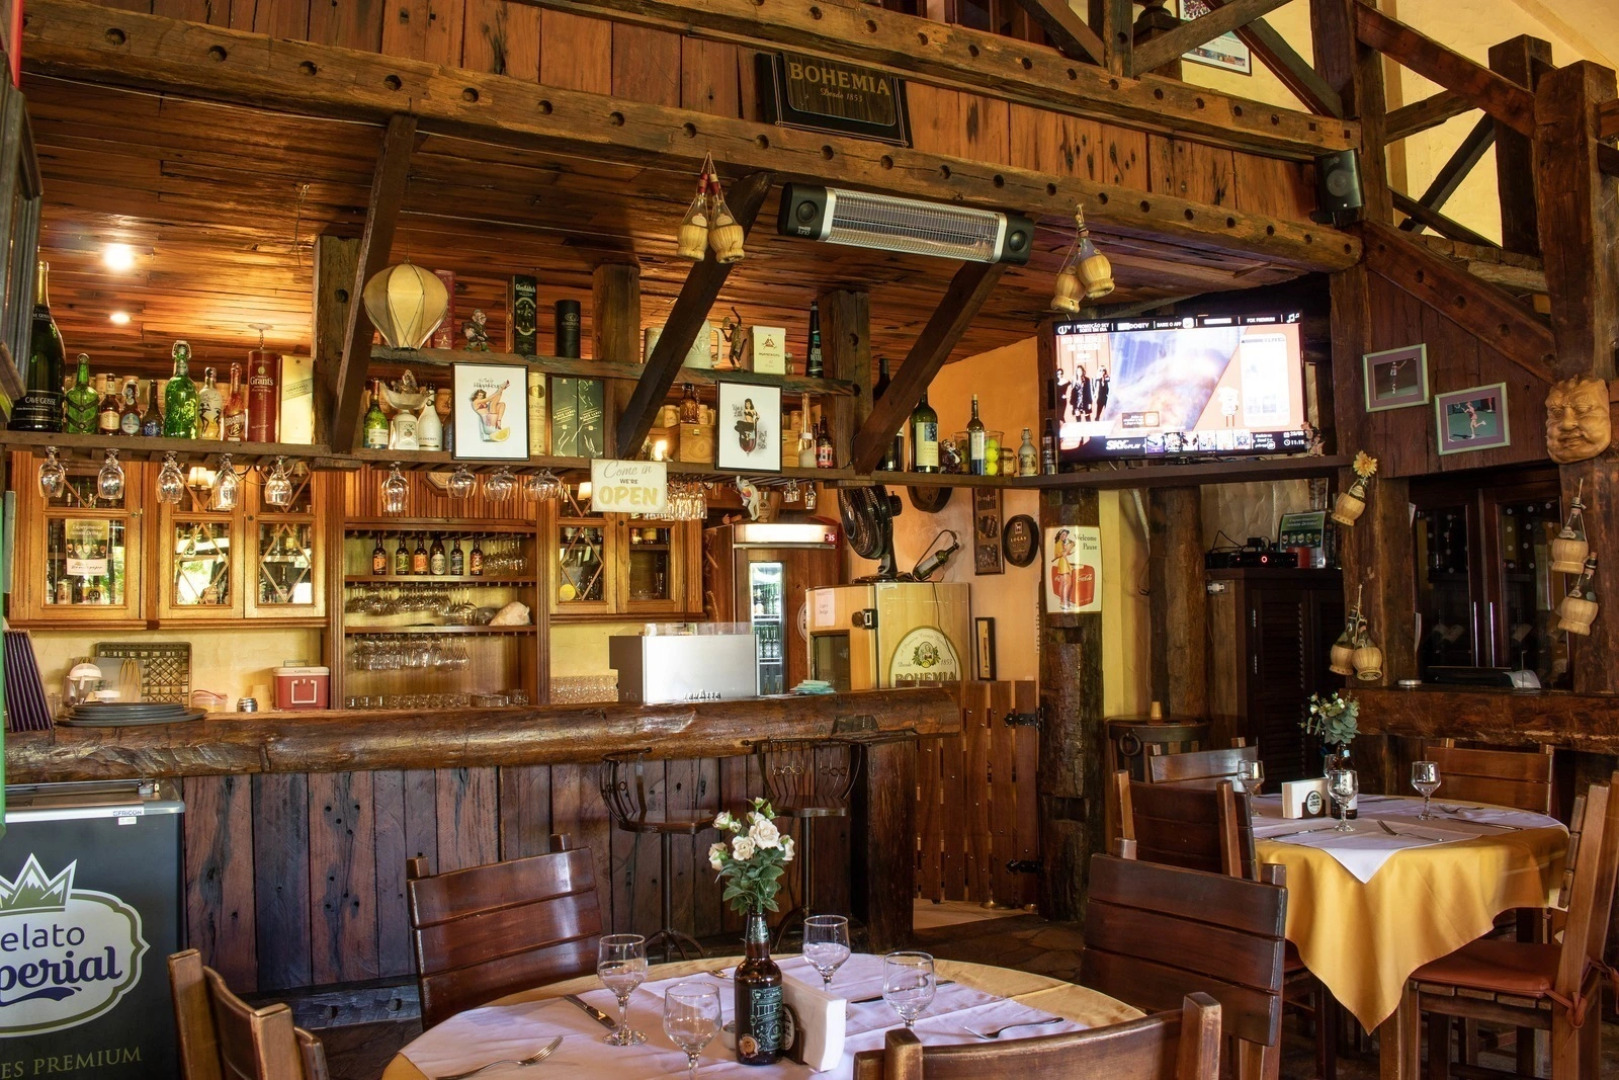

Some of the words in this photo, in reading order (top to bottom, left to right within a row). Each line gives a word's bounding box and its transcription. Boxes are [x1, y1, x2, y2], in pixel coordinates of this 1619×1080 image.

[789, 62, 891, 96] BOHEMIA
[819, 87, 844, 99] Desde
[250, 376, 274, 386] Grant's
[603, 460, 638, 478] Come
[641, 465, 653, 474] in
[598, 485, 658, 506] OPEN
[32, 1046, 142, 1075] PREMIUM
